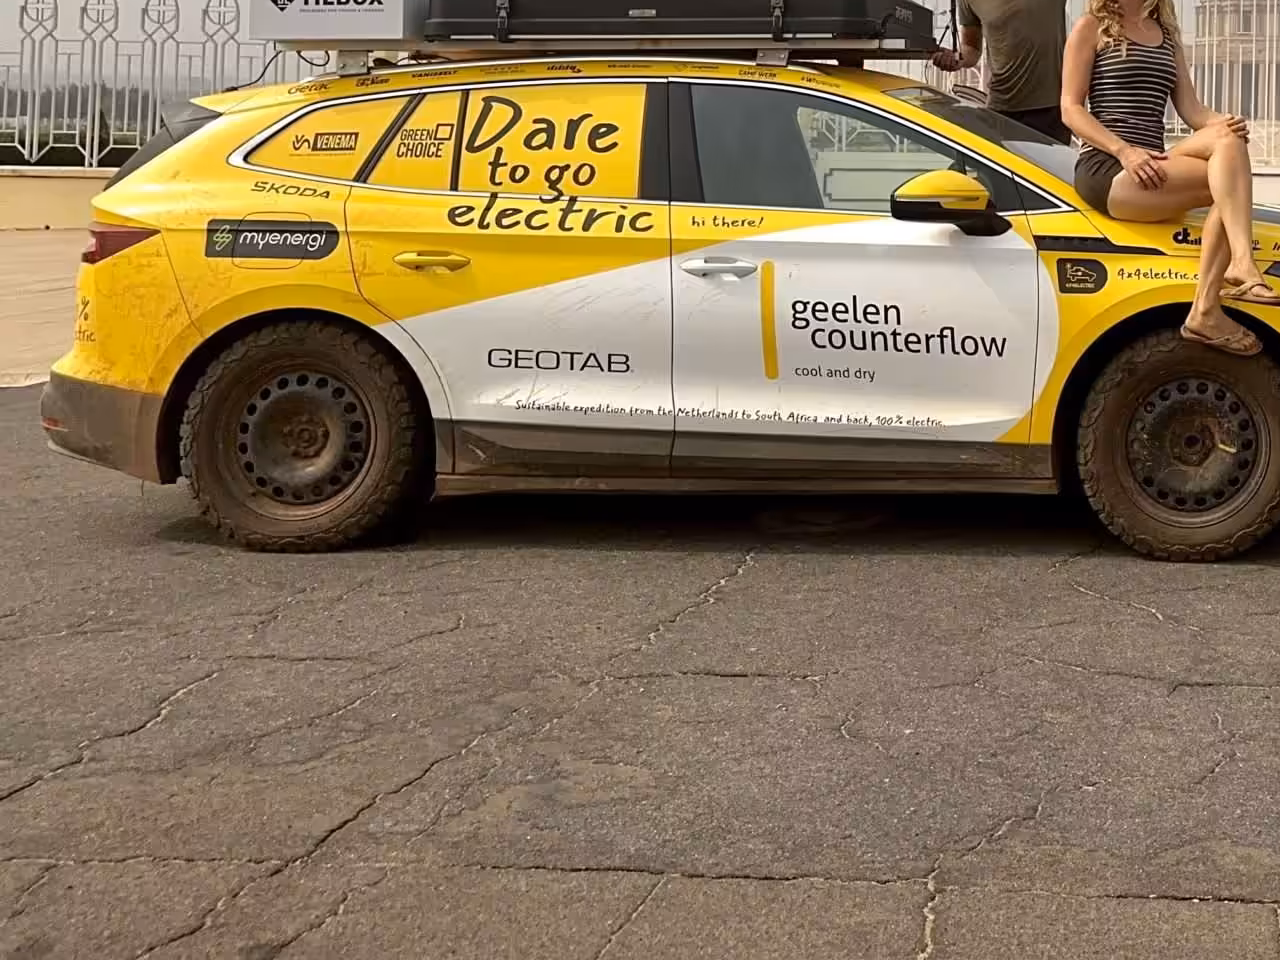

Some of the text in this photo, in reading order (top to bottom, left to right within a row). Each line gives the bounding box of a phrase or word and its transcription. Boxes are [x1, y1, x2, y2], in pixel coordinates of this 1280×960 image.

[400, 128, 434, 141] GREEN
[465, 96, 620, 153] Dare
[317, 134, 356, 149] VENEMA
[397, 142, 444, 158] CHOICE
[488, 146, 597, 204] to go
[447, 192, 655, 233] electric
[691, 215, 764, 229] hi there!
[239, 230, 327, 251] myenergi
[1117, 267, 1200, 280] 4x4electric.c
[791, 294, 901, 330] geelen
[811, 327, 1007, 358] counterflow
[487, 348, 631, 373] GEOTAB
[795, 365, 876, 382] cool and dry
[515, 399, 571, 412] Sustainable
[573, 403, 626, 415] expedition
[629, 406, 654, 417] from
[657, 406, 673, 416] the
[741, 409, 752, 420] to
[754, 409, 783, 422] South
[786, 411, 818, 424] Africa
[823, 414, 843, 424] and
[875, 414, 904, 426] 100%
